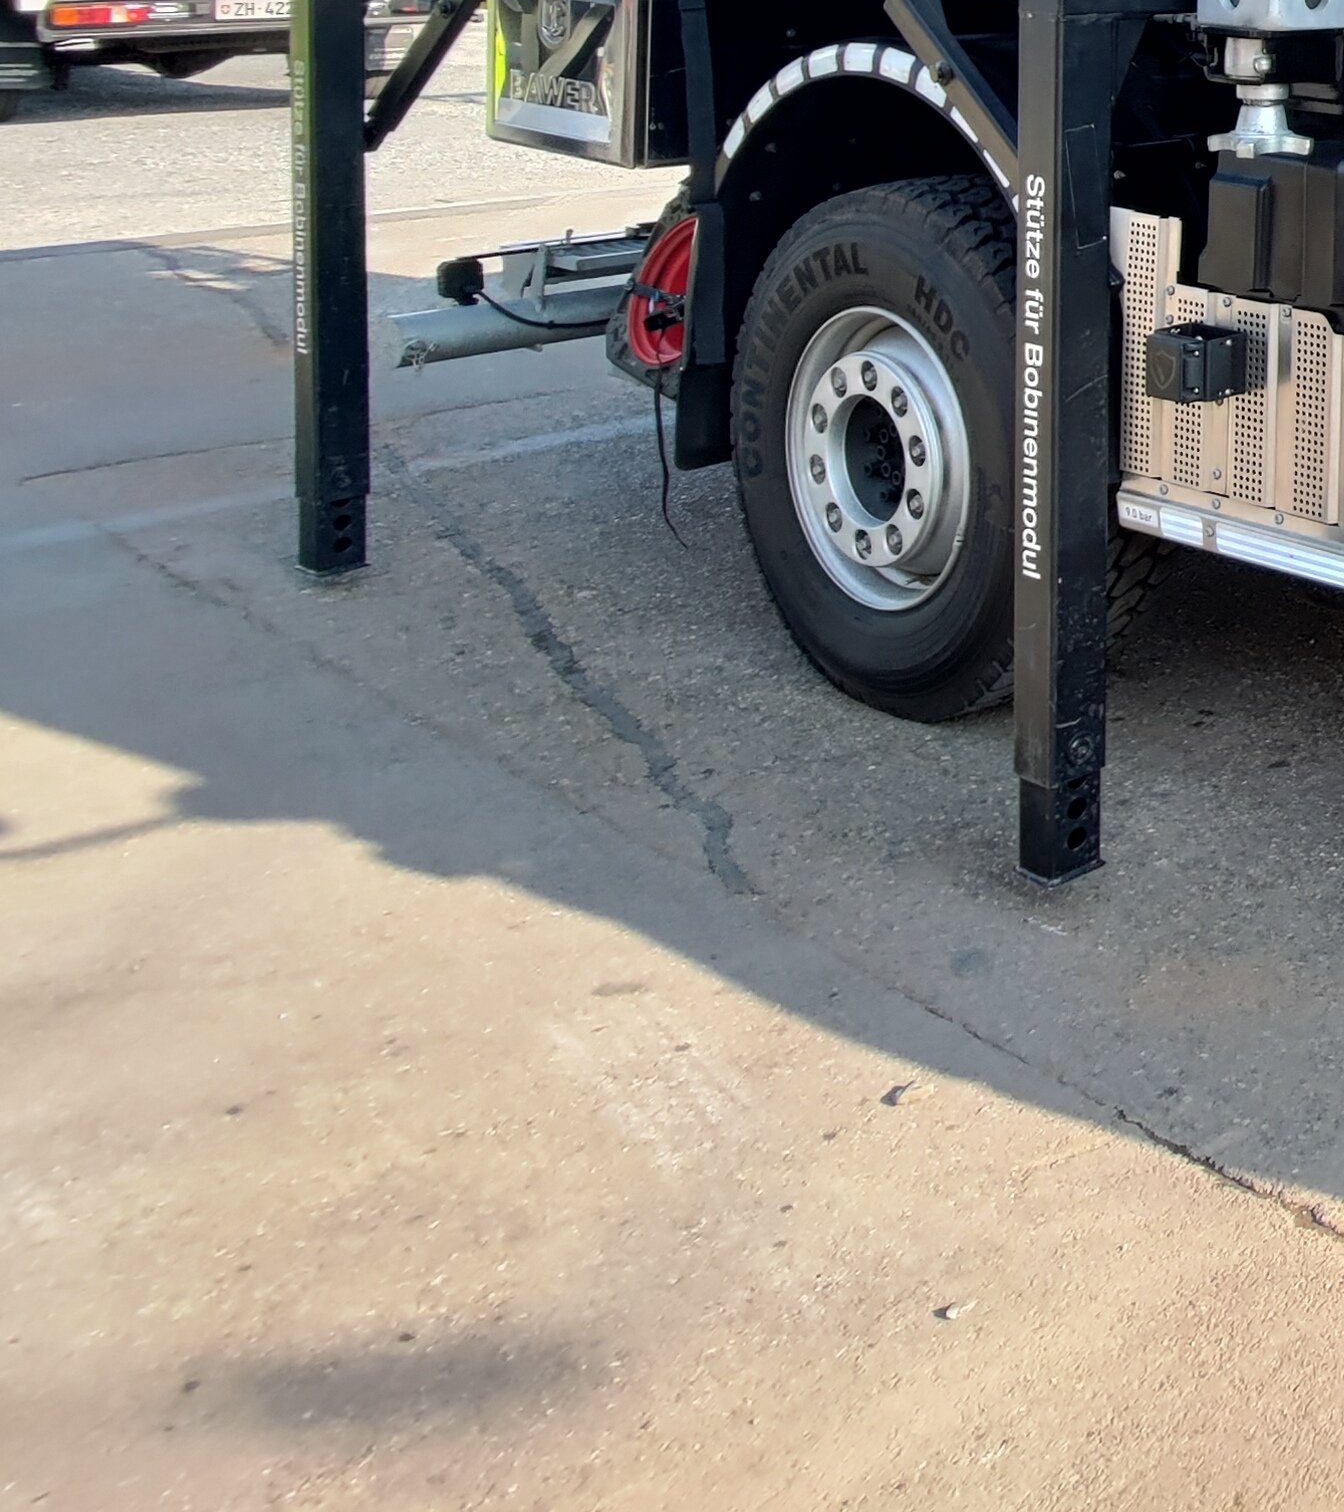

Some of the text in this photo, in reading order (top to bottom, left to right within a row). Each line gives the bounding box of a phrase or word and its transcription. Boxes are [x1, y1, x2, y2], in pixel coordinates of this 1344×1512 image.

[914, 274, 970, 362] HDC
[1022, 174, 1046, 579] Stütze für Bobinenmodul
[1139, 510, 1153, 522] bar
